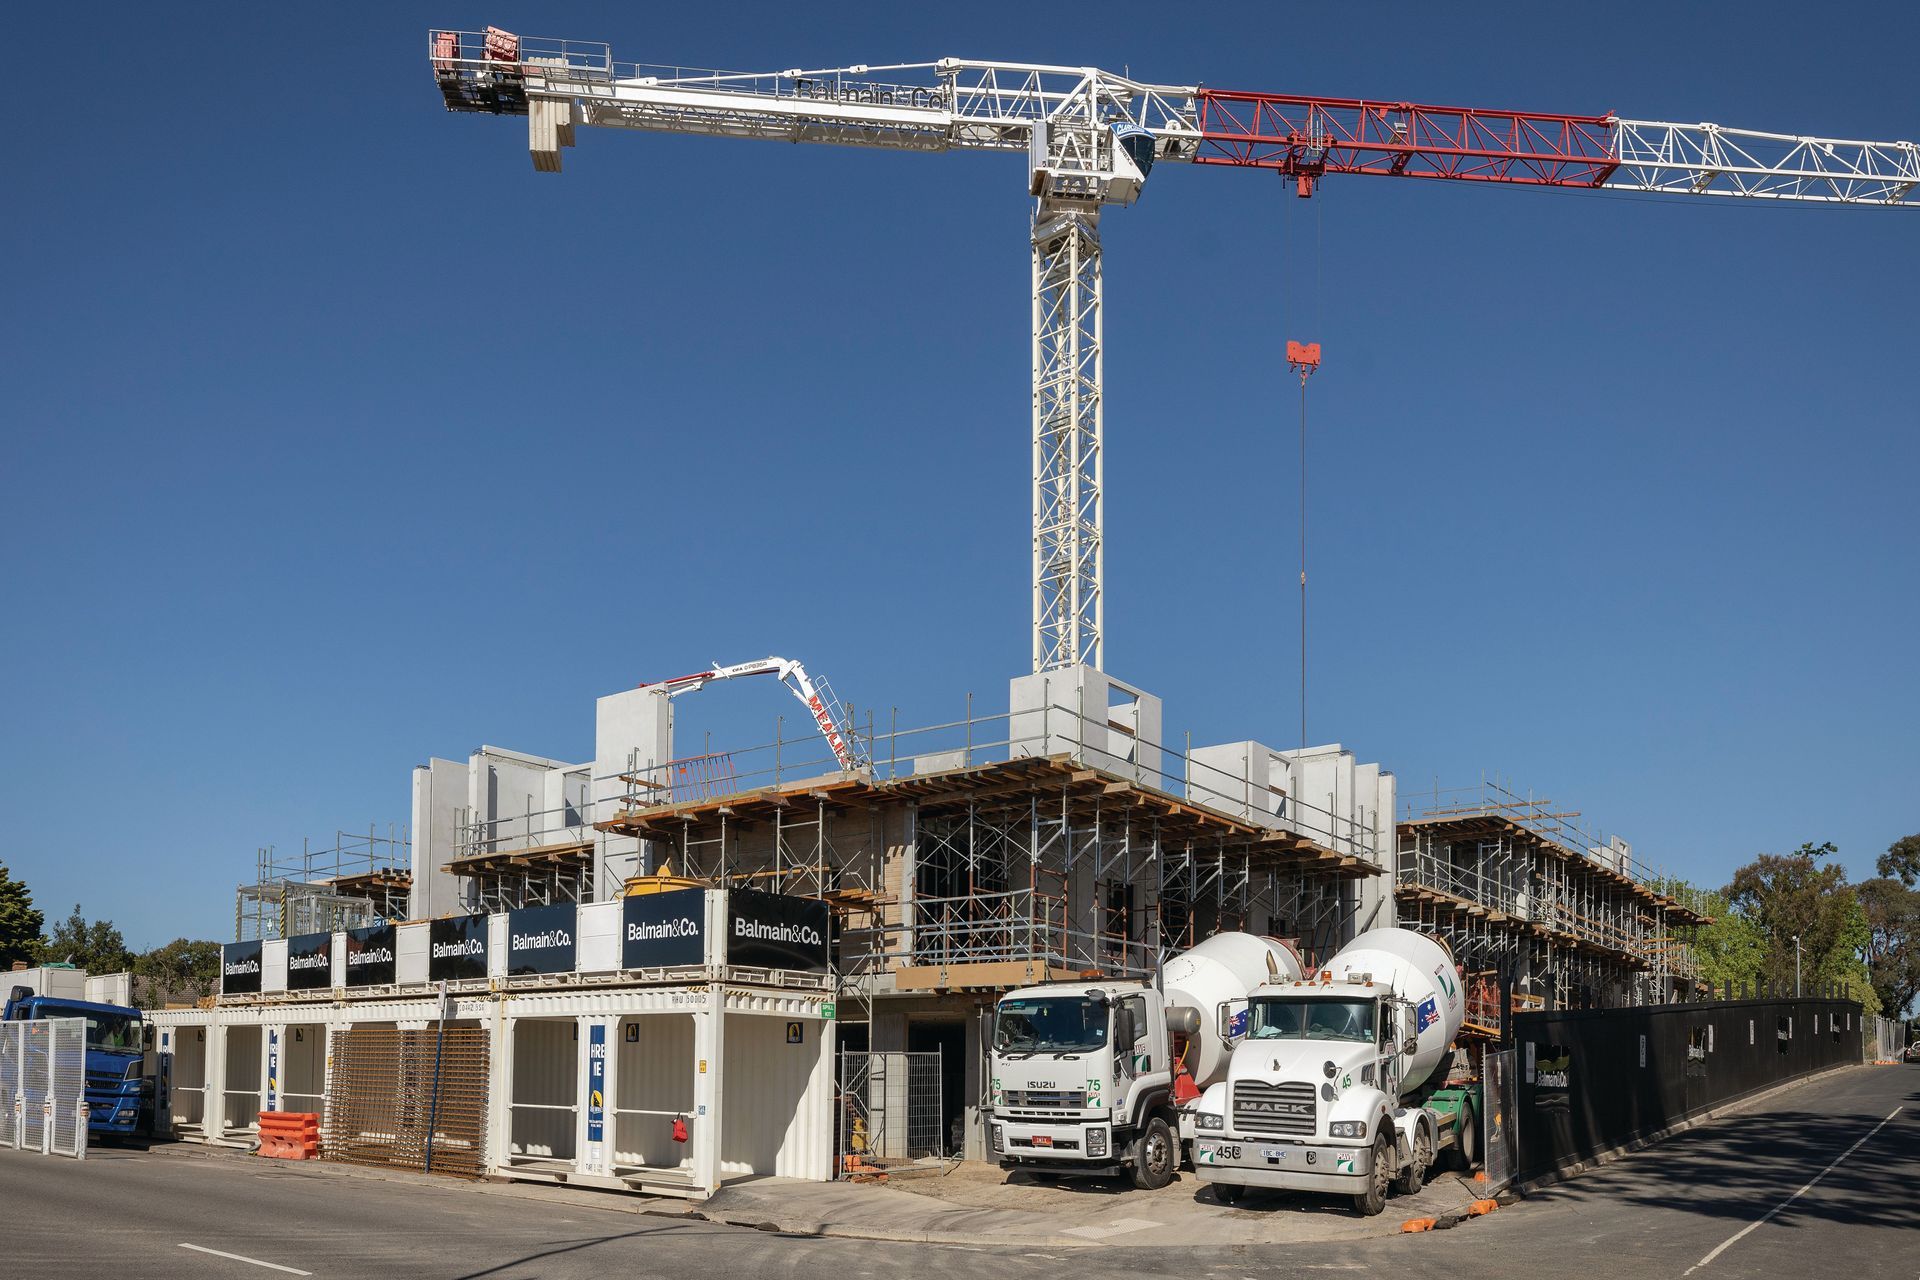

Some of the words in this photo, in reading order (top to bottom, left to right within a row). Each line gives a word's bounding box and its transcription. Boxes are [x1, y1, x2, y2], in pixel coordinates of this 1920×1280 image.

[628, 917, 699, 941] Balmain&Co.
[735, 917, 822, 945] Balmain&Co.
[512, 930, 571, 950] Balmain&Co.
[349, 948, 393, 965] Balmain&Co.
[433, 939, 484, 958] Balmain&Co.
[225, 960, 260, 975] Balmain&Co.
[290, 954, 329, 970] Balmain&Co.
[992, 1078, 1001, 1090] 75
[1027, 1081, 1056, 1089] ISUZU
[1087, 1079, 1101, 1091] 75
[1342, 1073, 1352, 1089] 45
[1240, 1102, 1310, 1113] MACK
[1216, 1145, 1232, 1159] 45
